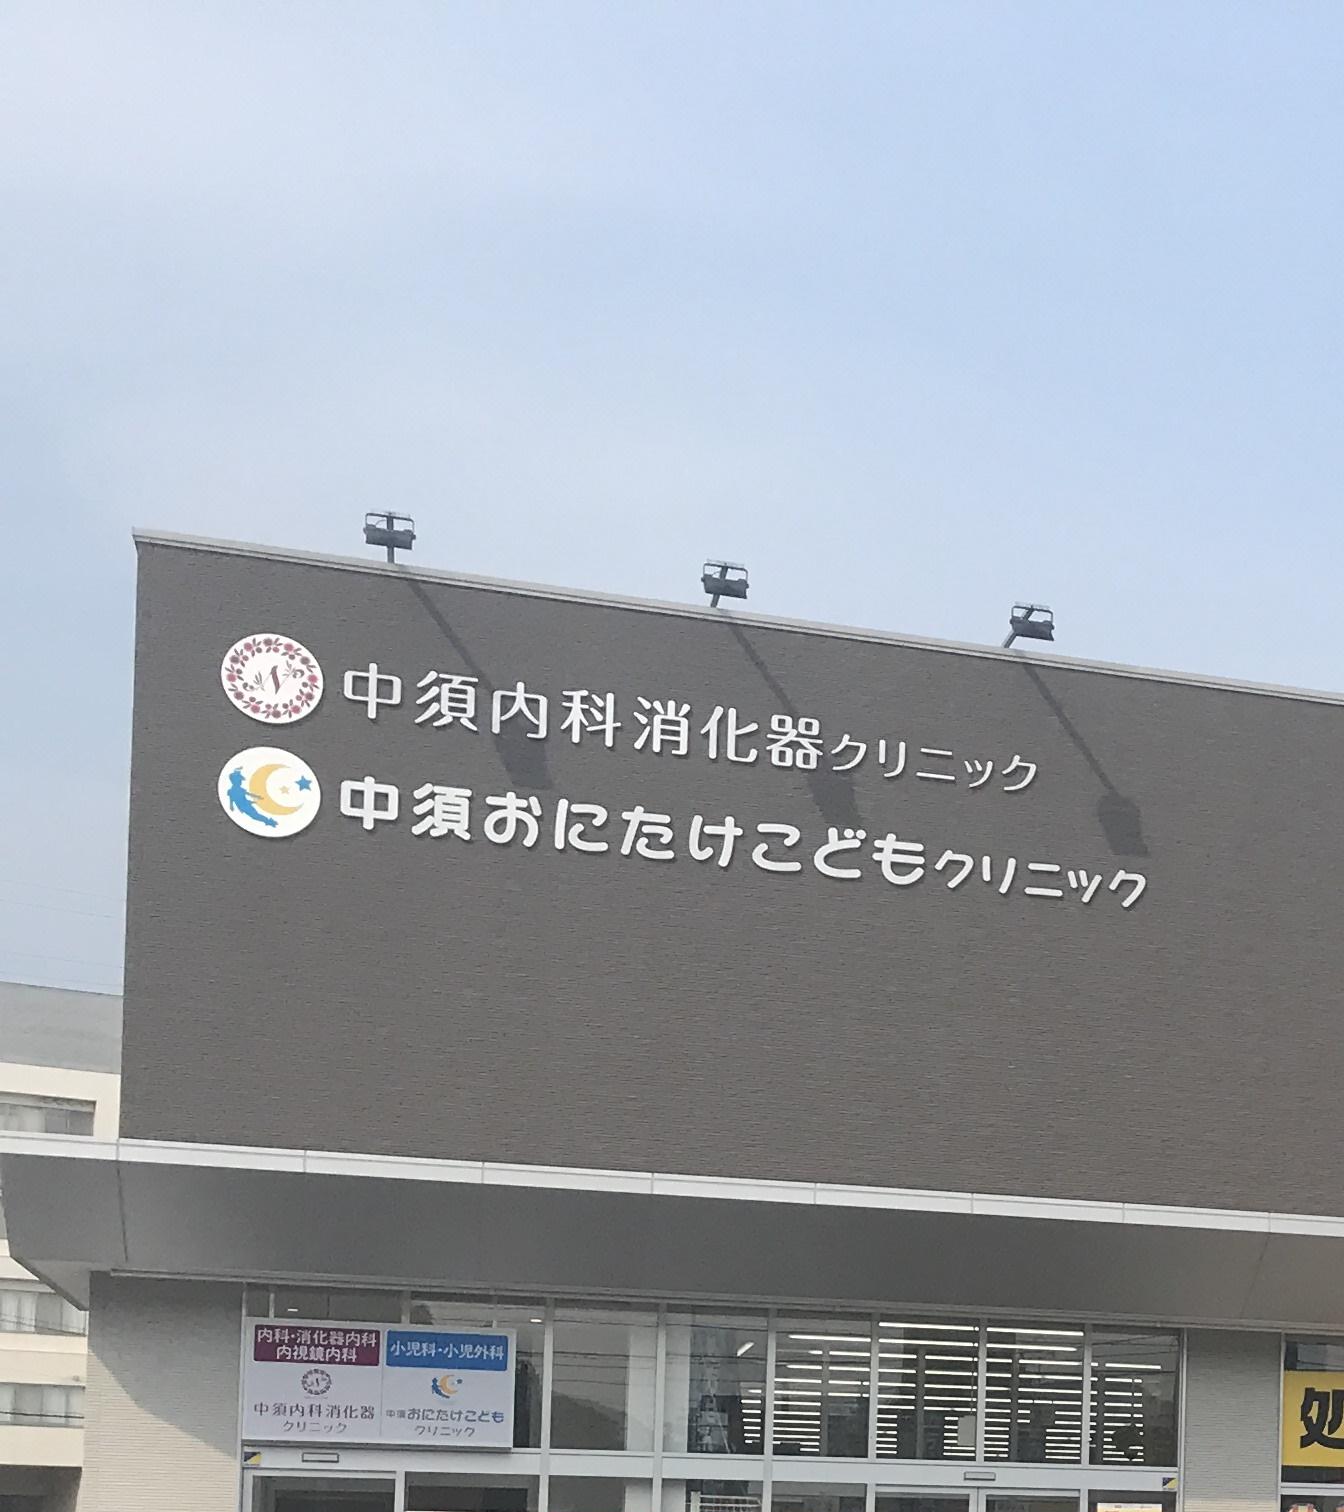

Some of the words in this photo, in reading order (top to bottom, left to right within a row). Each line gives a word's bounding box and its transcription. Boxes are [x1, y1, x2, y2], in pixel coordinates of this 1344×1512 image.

[342, 661, 1039, 793] 中須内科消化器クリニック
[338, 774, 1149, 909] 中須おにたけこどもクリニック
[257, 1327, 377, 1348] 内科・消化器内科
[276, 1345, 358, 1363] 内視鏡内科
[390, 1341, 505, 1361] 小児科・小児外科
[254, 1402, 375, 1420] 中須内科消化器
[282, 1420, 348, 1434] クリニック
[415, 1425, 476, 1438] クリニック
